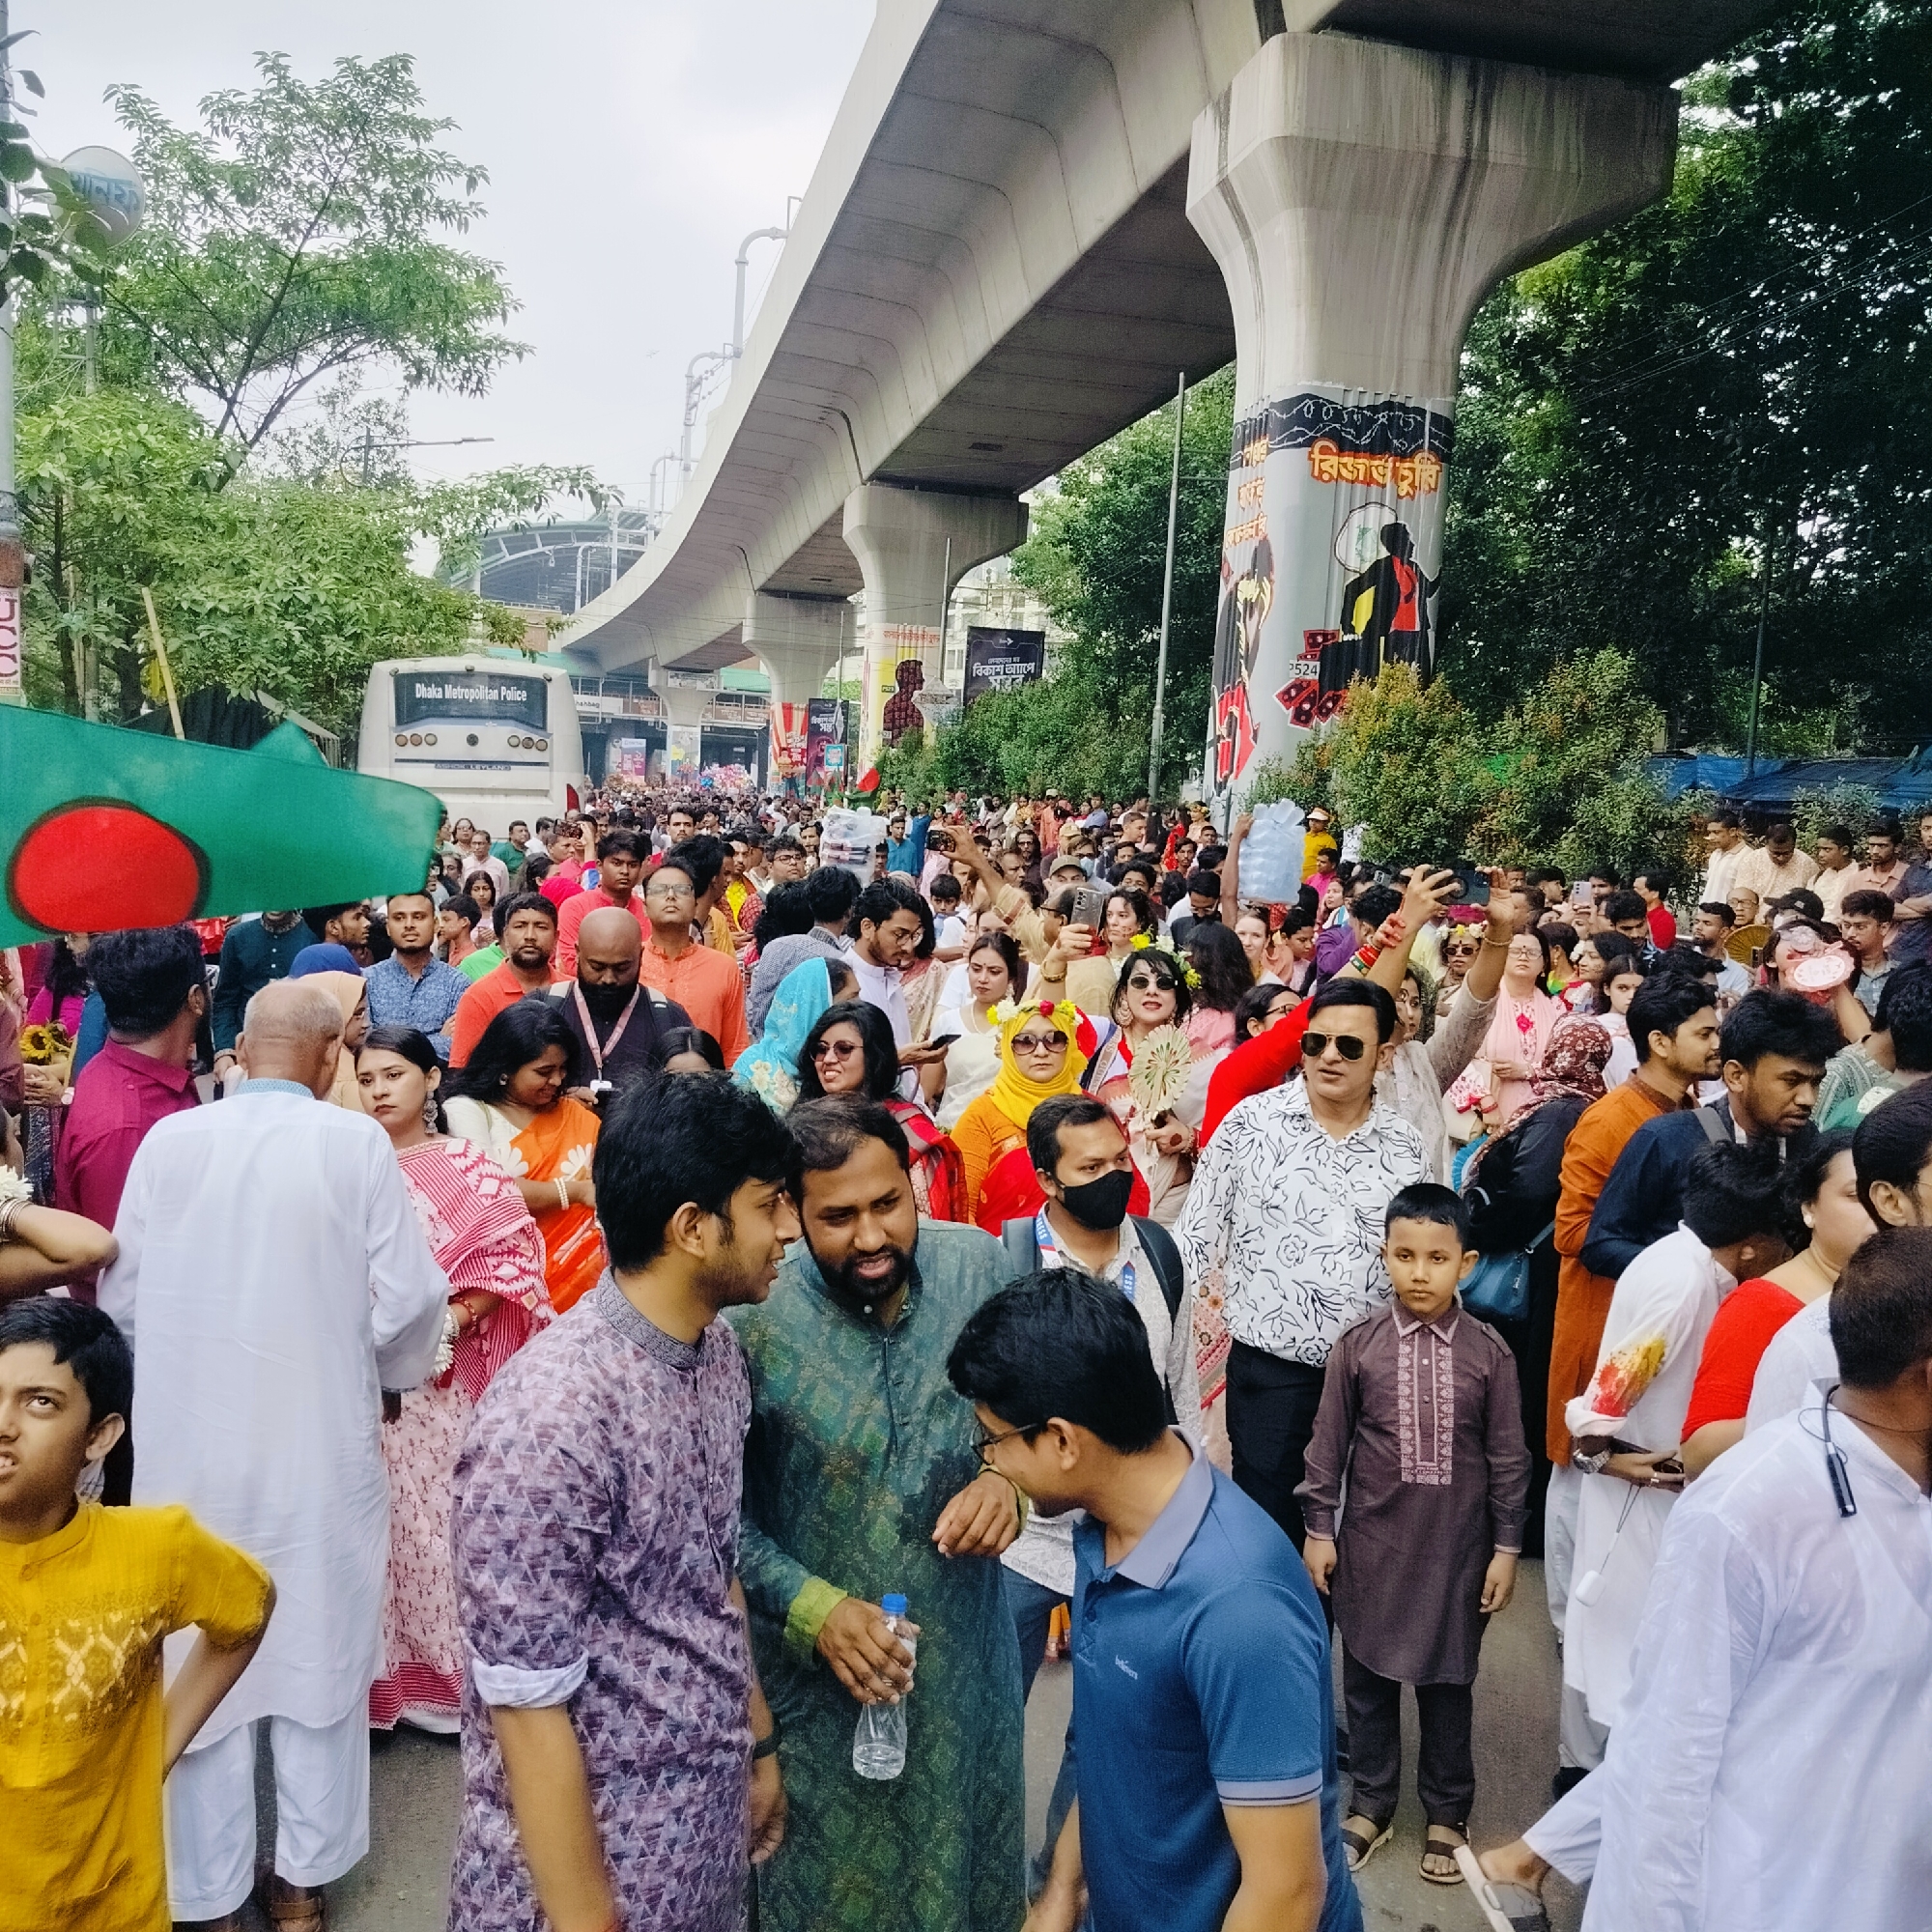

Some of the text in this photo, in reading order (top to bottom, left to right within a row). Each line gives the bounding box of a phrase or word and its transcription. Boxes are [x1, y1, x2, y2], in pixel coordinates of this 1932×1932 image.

[972, 662, 1036, 677] বিকাশ অ্যাপে
[415, 683, 527, 703] Dhaka Metropolitan Police
[576, 700, 601, 709] hahbag
